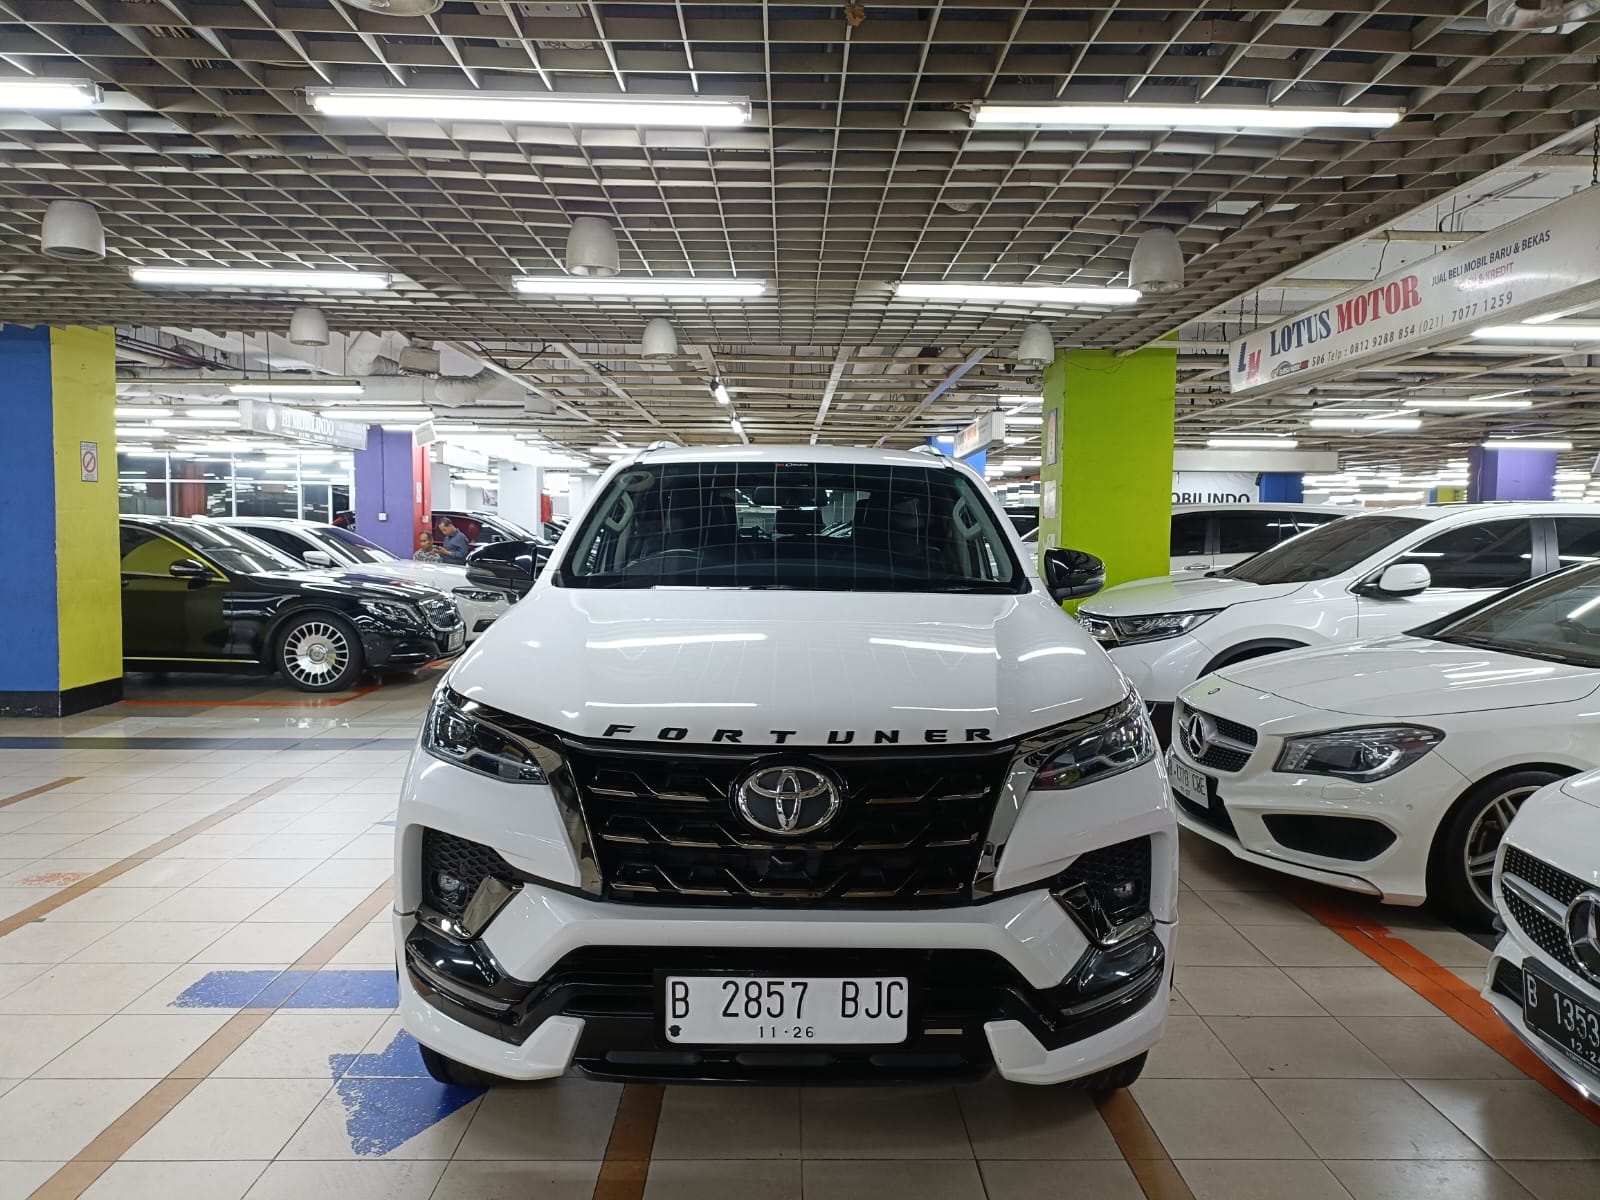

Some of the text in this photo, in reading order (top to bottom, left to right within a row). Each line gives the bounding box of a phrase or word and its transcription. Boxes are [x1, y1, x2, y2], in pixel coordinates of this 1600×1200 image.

[1431, 230, 1551, 287] JUAL BELI MOBIL BARU & BEKAS
[1486, 261, 1515, 281] KREDIT
[1270, 275, 1422, 357] LOTUS MOTOR
[1349, 339, 1369, 354] 0812
[1372, 331, 1395, 348] 9288
[1398, 324, 1415, 340] 854
[1419, 314, 1444, 335] (021)
[1451, 302, 1478, 323] 7077
[1484, 291, 1513, 312] 1259
[602, 724, 993, 744] FORTUNER
[671, 980, 904, 1019] B 2857 BJC
[1526, 973, 1600, 1048] B 1353
